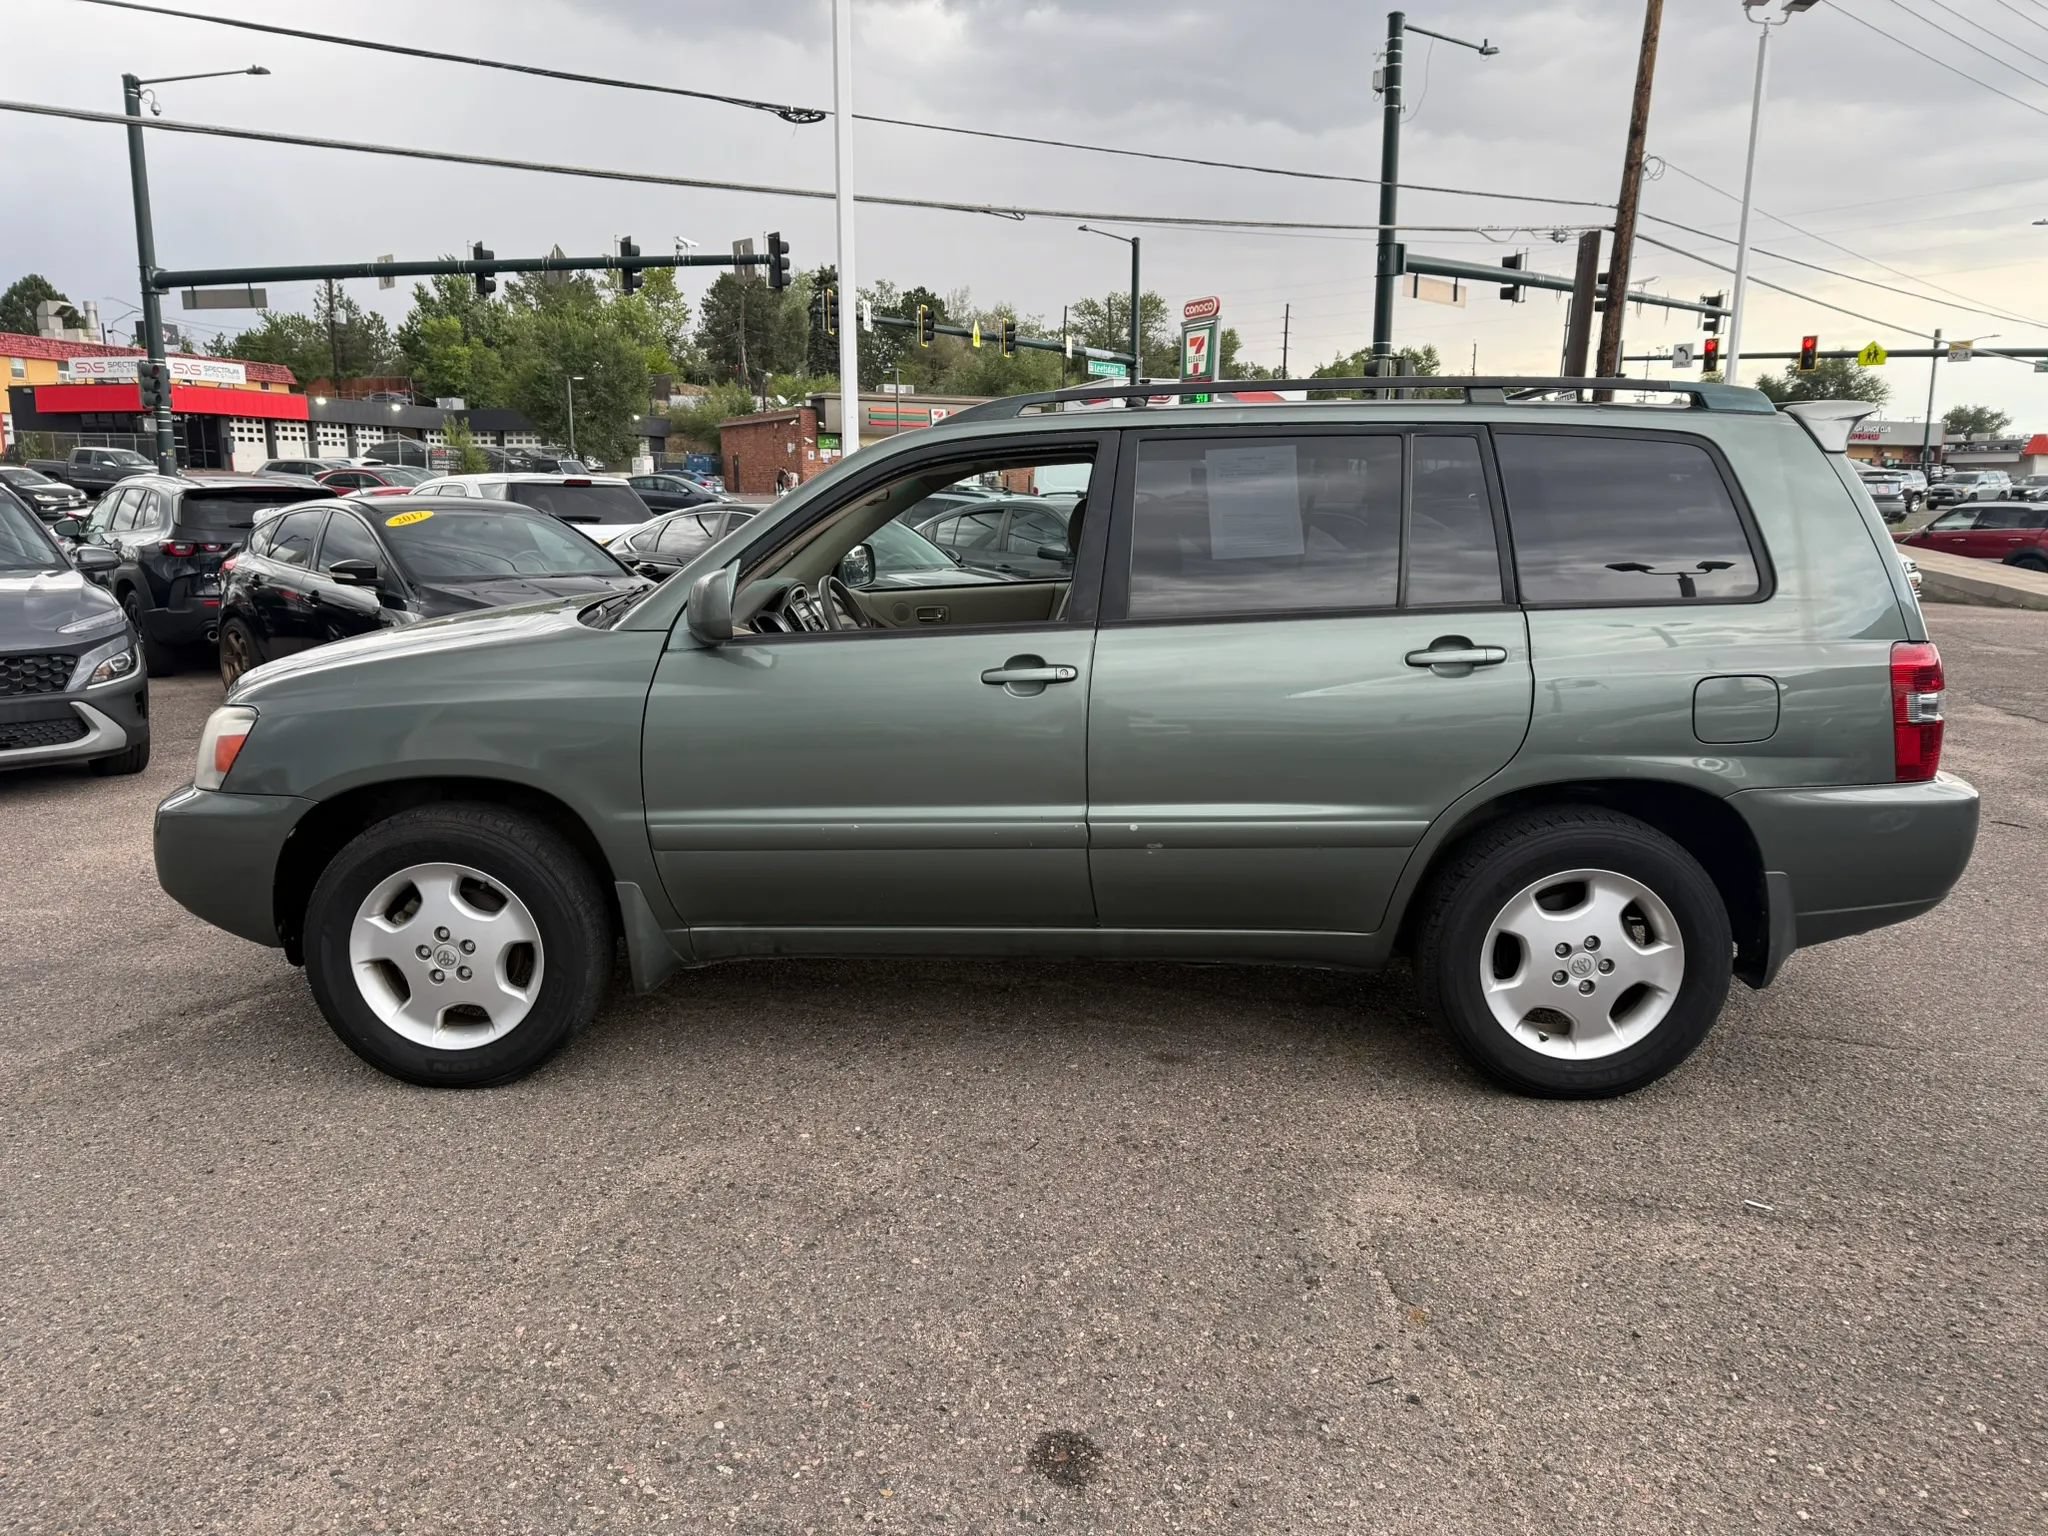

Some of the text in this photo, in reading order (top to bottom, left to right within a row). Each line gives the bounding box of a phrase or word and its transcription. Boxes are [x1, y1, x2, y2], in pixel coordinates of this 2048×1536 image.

[107, 361, 138, 369] SPECTR
[204, 365, 240, 375] SPECTRUM
[395, 512, 423, 524] 2017
